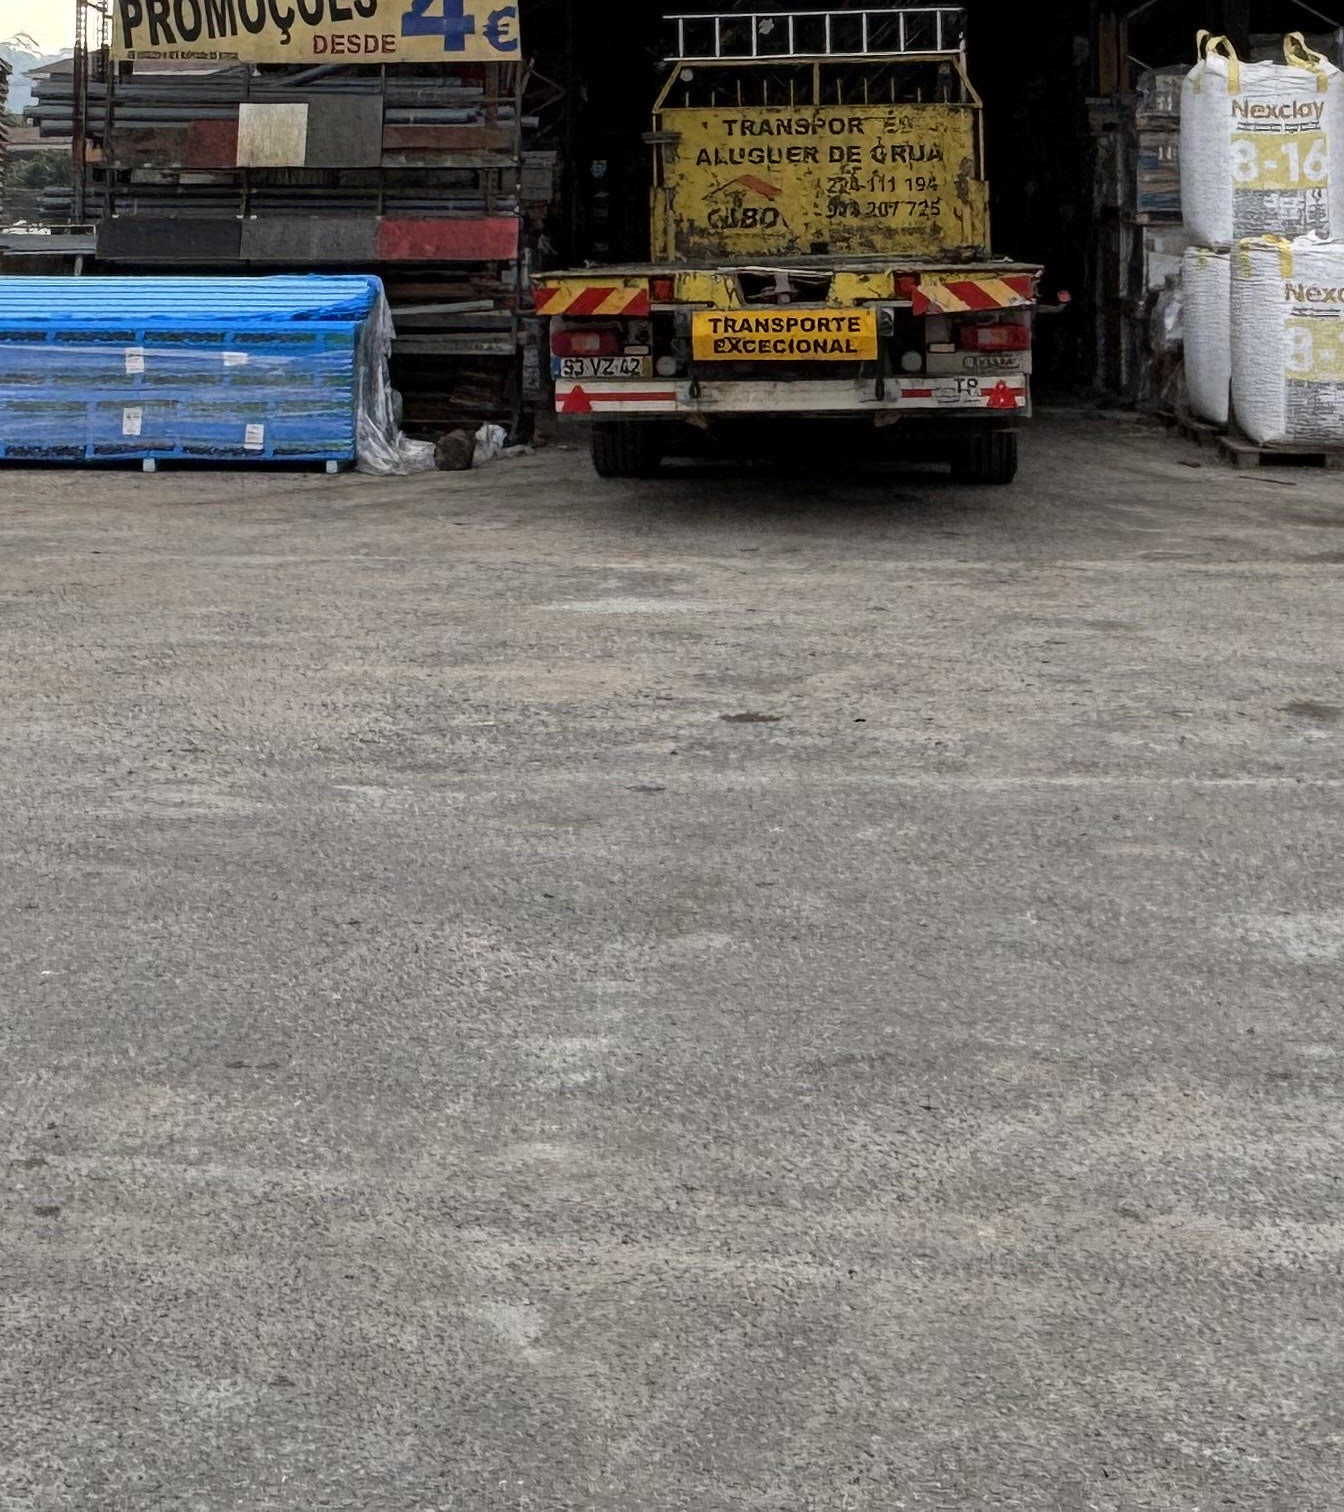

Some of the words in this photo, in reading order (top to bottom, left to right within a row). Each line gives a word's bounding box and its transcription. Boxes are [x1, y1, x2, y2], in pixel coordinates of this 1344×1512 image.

[312, 32, 397, 55] DESDE
[1231, 98, 1324, 122] Nexclay
[696, 145, 820, 166] ALUGUER
[828, 145, 862, 164] DE
[870, 144, 945, 165] GRUA
[708, 316, 862, 335] TRANSPORTE
[713, 337, 859, 355] EXCECIONAL
